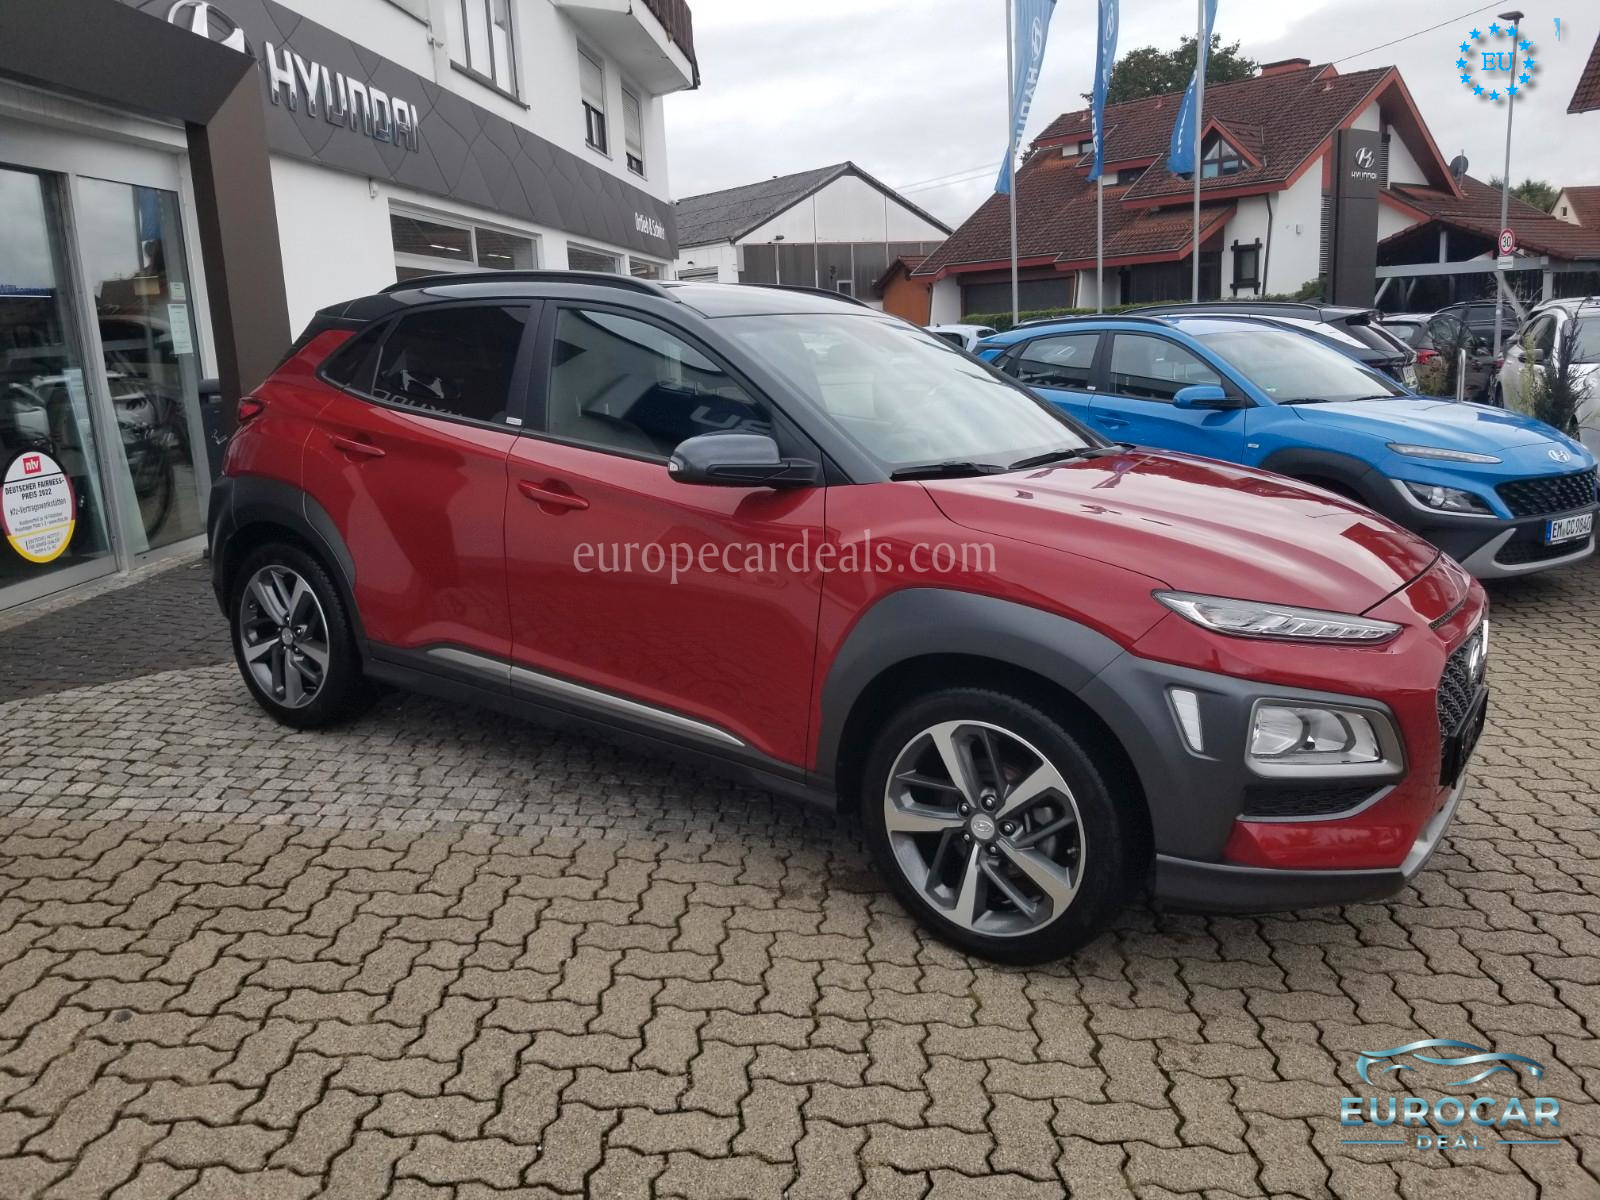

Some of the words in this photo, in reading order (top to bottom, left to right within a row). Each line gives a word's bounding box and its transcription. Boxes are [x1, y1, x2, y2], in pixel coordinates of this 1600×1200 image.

[265, 41, 419, 153] HYUNDAI
[1502, 235, 1511, 248] 30
[5, 482, 37, 495] DEUTSCHER
[21, 490, 38, 500] PREIS
[38, 488, 52, 497] 2022
